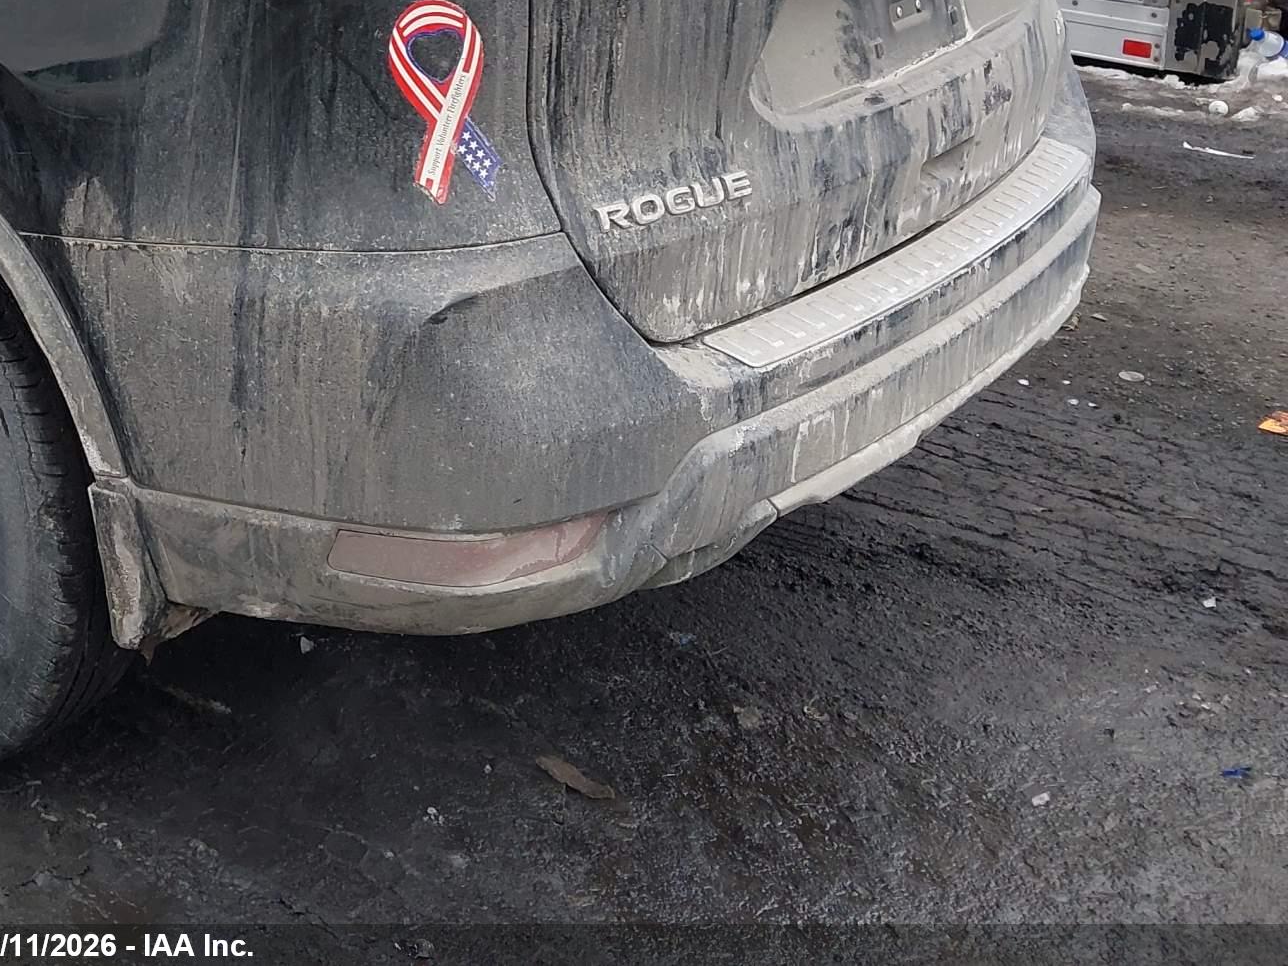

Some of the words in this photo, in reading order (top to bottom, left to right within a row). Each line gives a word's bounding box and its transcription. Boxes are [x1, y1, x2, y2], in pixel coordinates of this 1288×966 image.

[429, 148, 443, 175] Support
[437, 115, 453, 146] Volunteer
[447, 75, 466, 115] Firefighters
[590, 170, 754, 234] ROGUE
